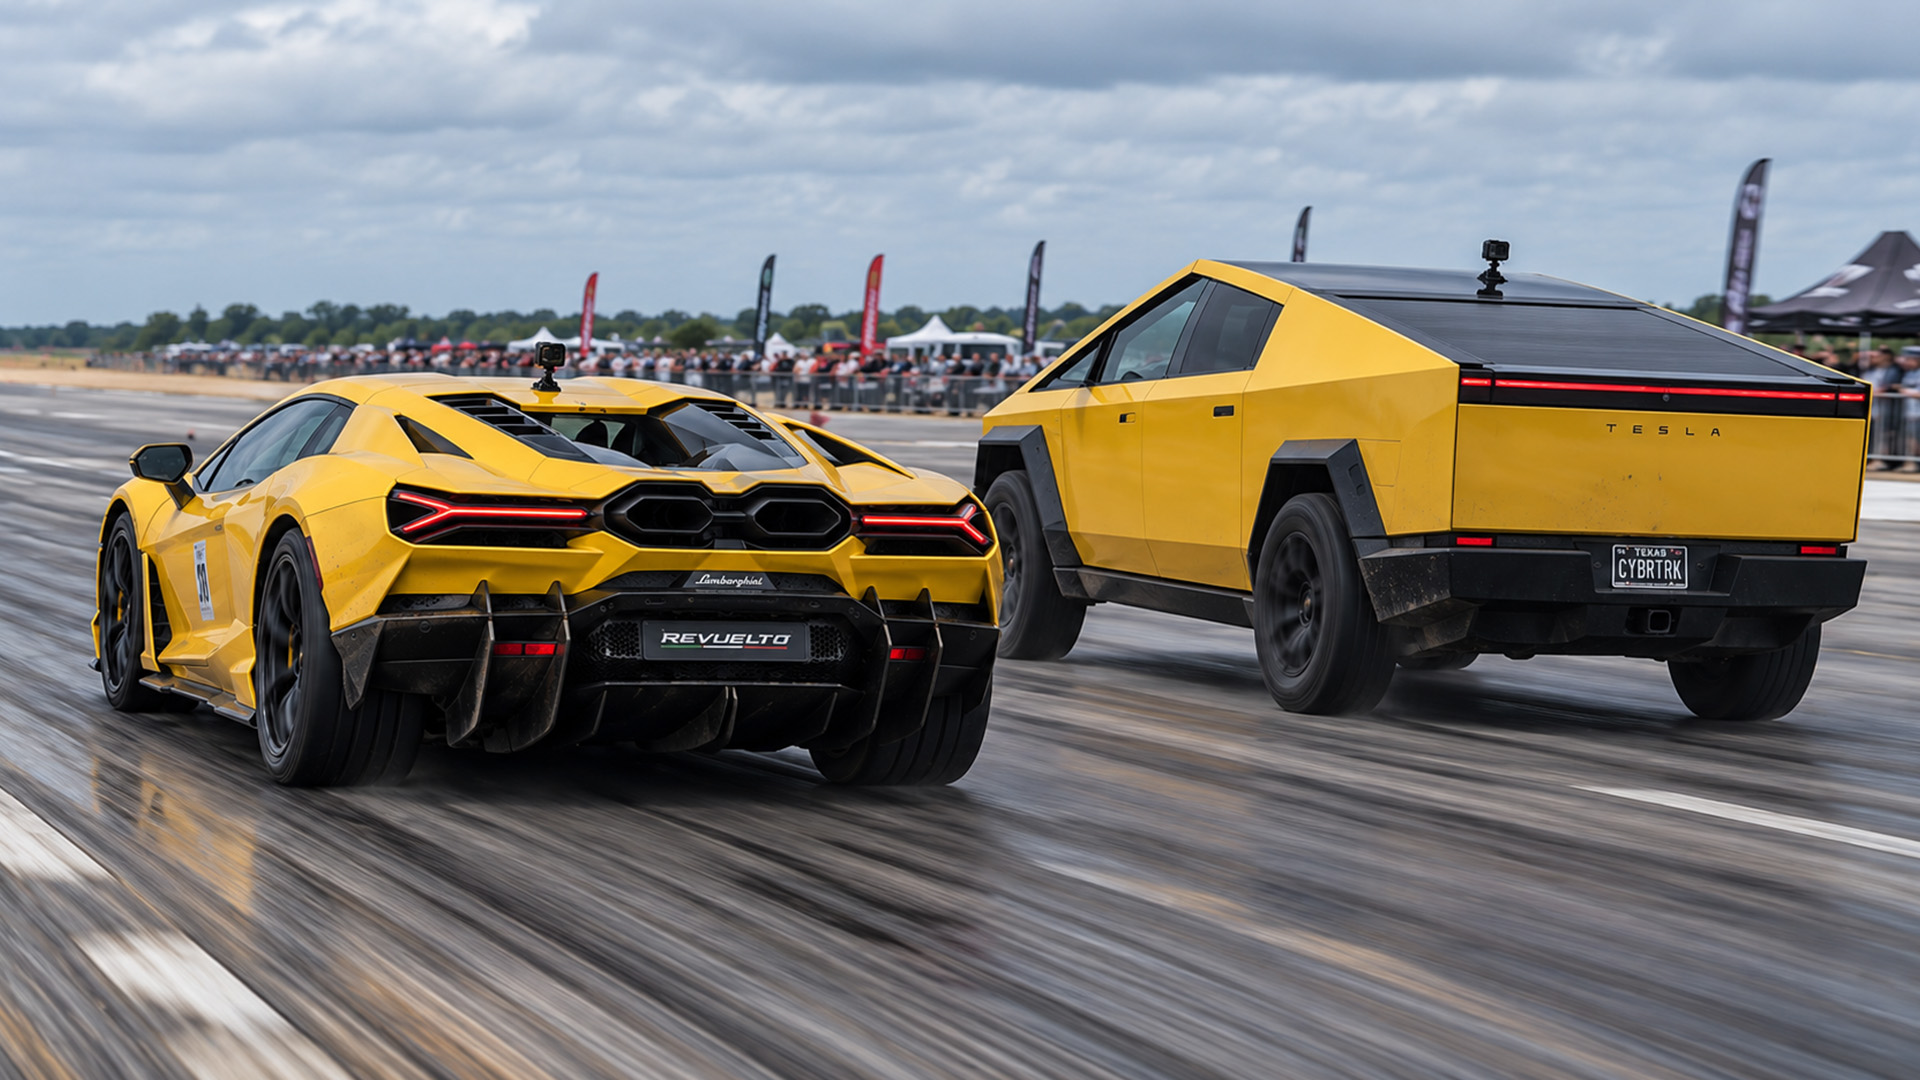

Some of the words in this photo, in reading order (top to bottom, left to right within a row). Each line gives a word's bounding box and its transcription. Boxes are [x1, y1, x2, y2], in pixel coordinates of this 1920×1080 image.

[1606, 423, 1721, 437] TESLA
[1618, 558, 1682, 580] CYBRTRK
[660, 632, 792, 645] REVUELTO
